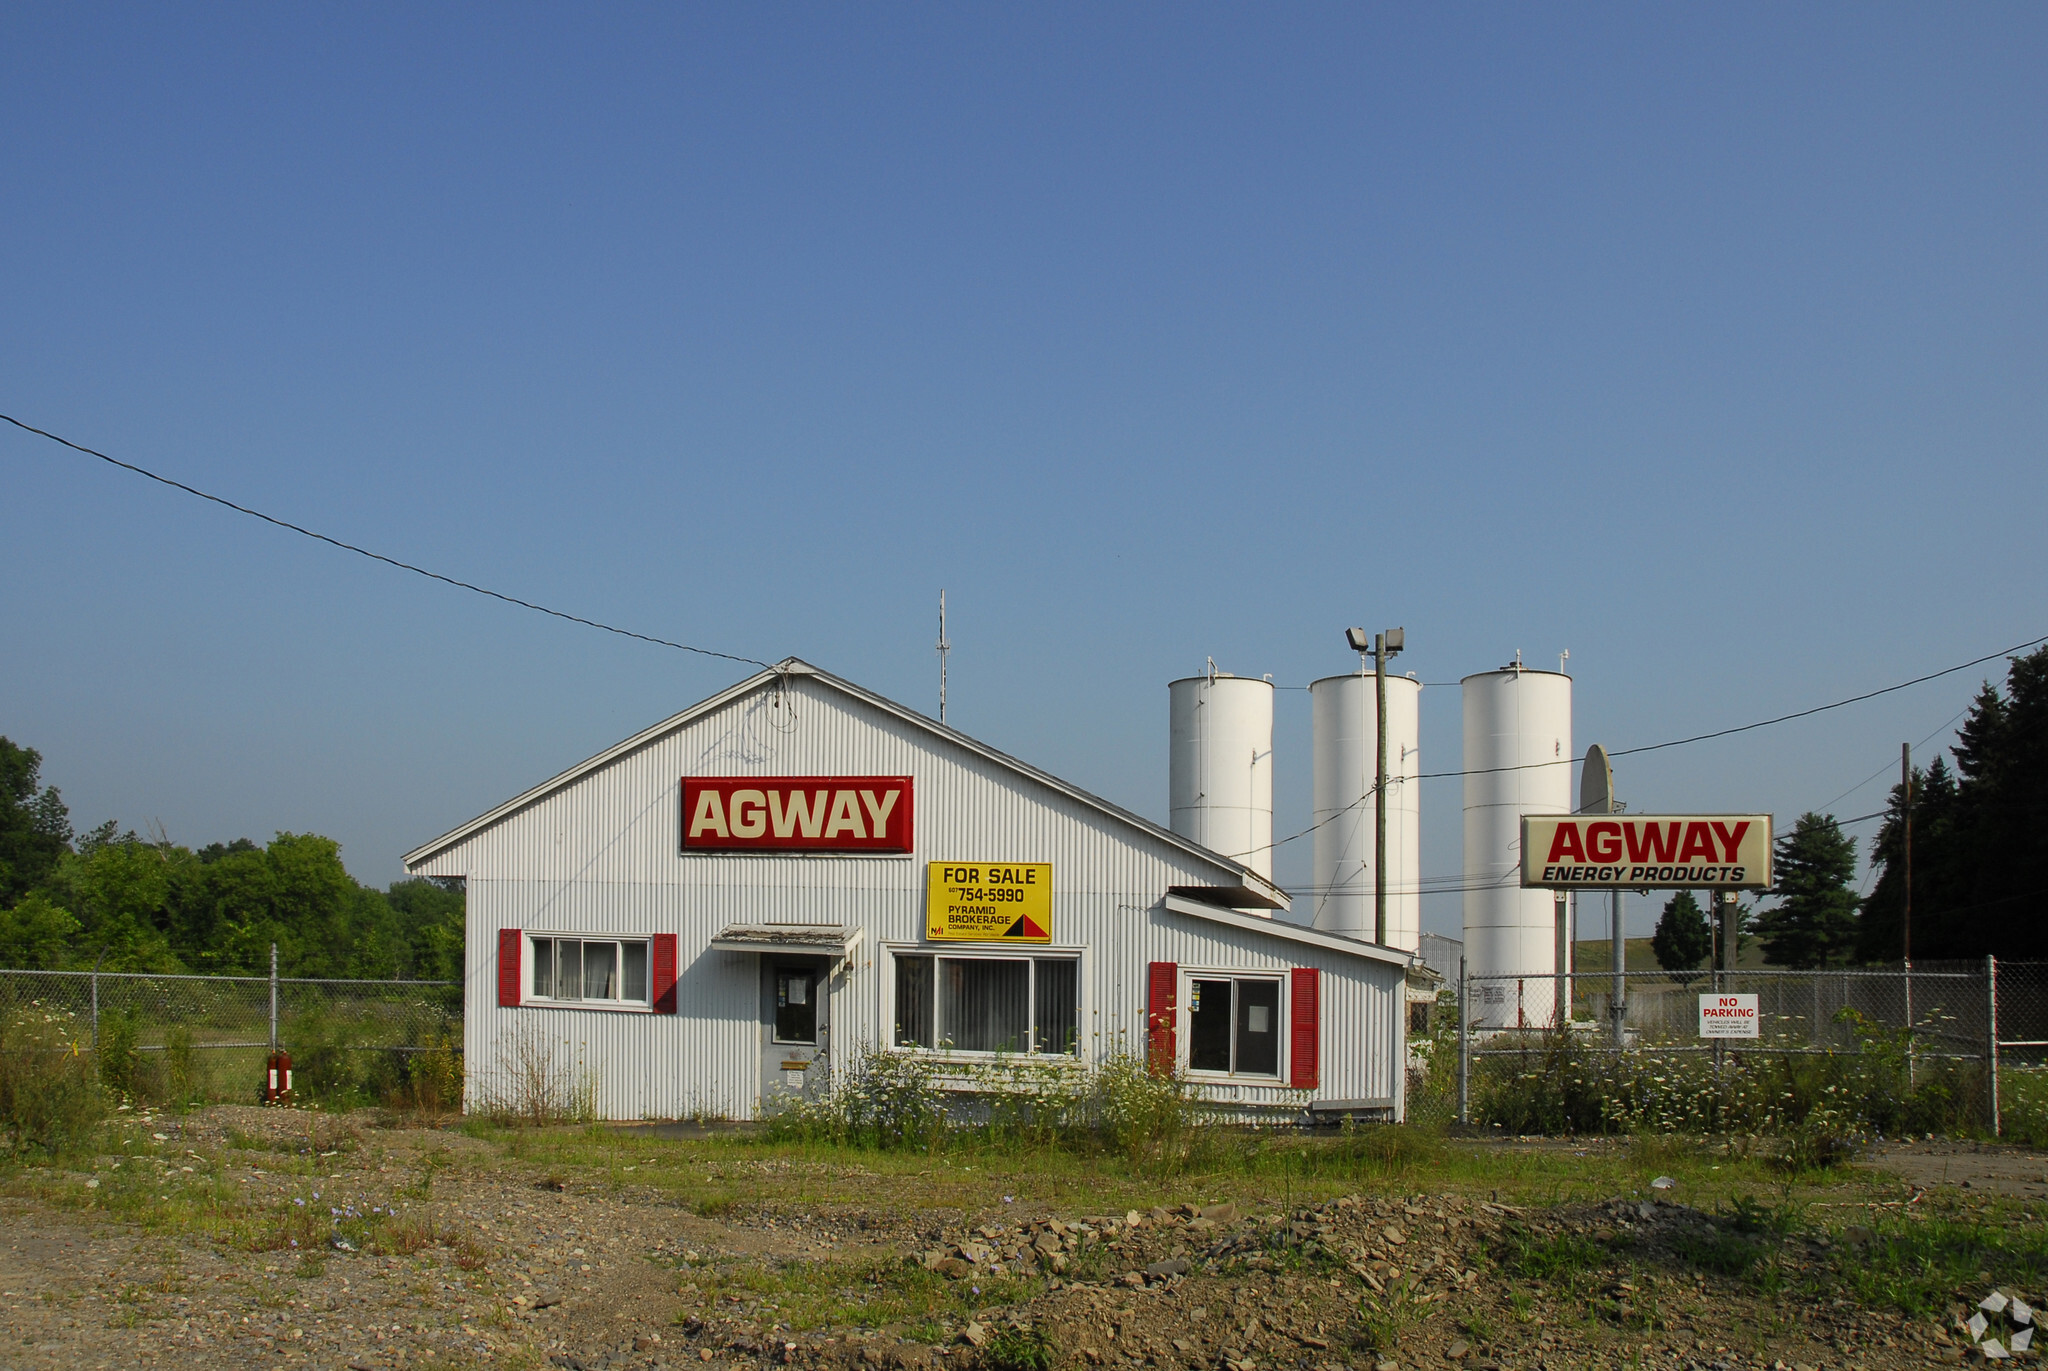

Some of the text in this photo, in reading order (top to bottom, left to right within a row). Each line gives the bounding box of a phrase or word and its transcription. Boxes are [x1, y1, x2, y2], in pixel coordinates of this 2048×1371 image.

[689, 789, 901, 839] AGWAY
[1547, 821, 1751, 863] AGWAY
[944, 868, 1036, 885] FOR SALE
[1542, 866, 1745, 882] ENERGY PRODUCTS
[958, 888, 1024, 903] 754-5990
[948, 905, 996, 915] PYRAMID
[948, 915, 1011, 925] BROKERAGE
[931, 925, 944, 936] NAI
[1719, 998, 1738, 1007] NO
[1703, 1008, 1754, 1017] PARKING
